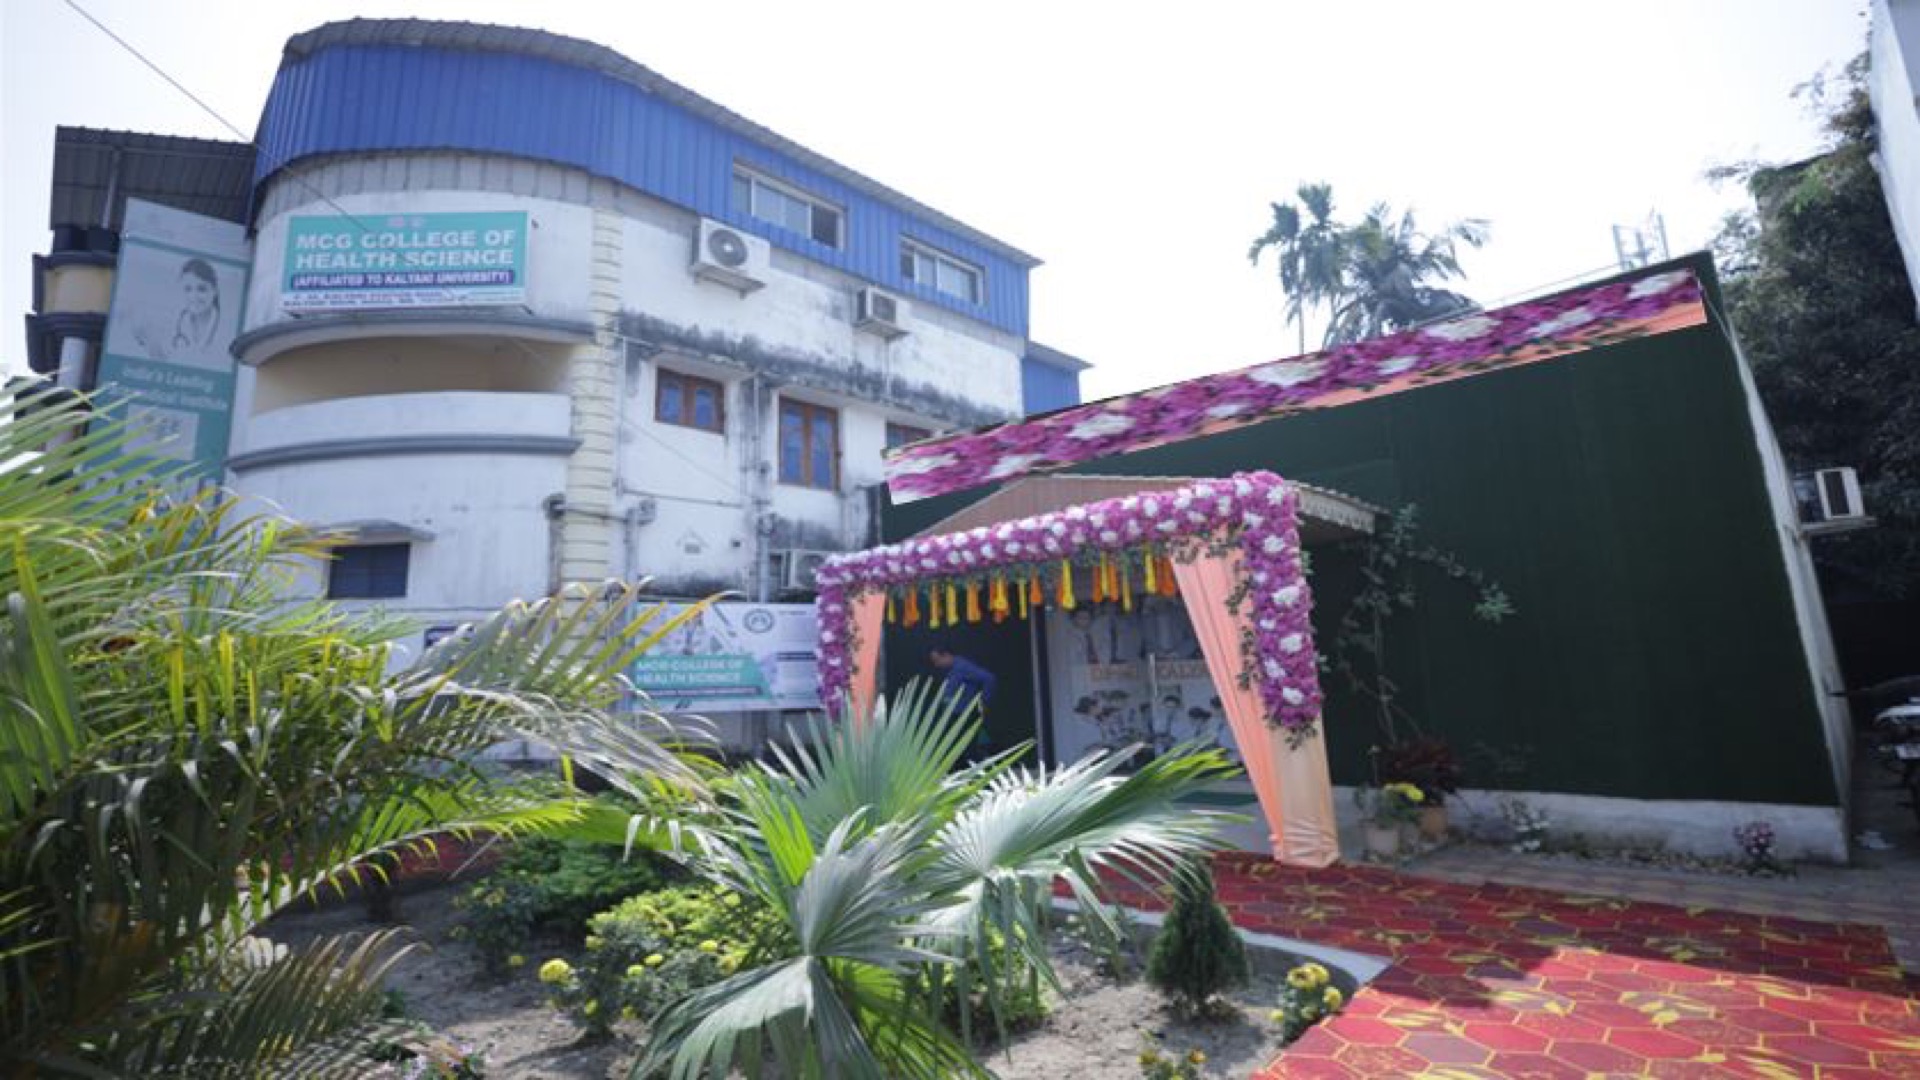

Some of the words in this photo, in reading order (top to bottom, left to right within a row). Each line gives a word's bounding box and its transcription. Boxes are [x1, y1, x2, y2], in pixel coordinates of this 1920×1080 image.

[296, 233, 352, 249] MCG
[360, 230, 477, 249] COLLEGE
[484, 229, 515, 247] OF
[295, 251, 397, 269] HEALTH
[404, 249, 514, 266] SCIENCE
[367, 273, 383, 285] TO
[166, 370, 213, 392] Leading
[671, 658, 727, 670] COLLEGE
[728, 658, 743, 669] OF
[637, 672, 685, 684] HEALTH
[689, 671, 740, 683] SCIENCE
